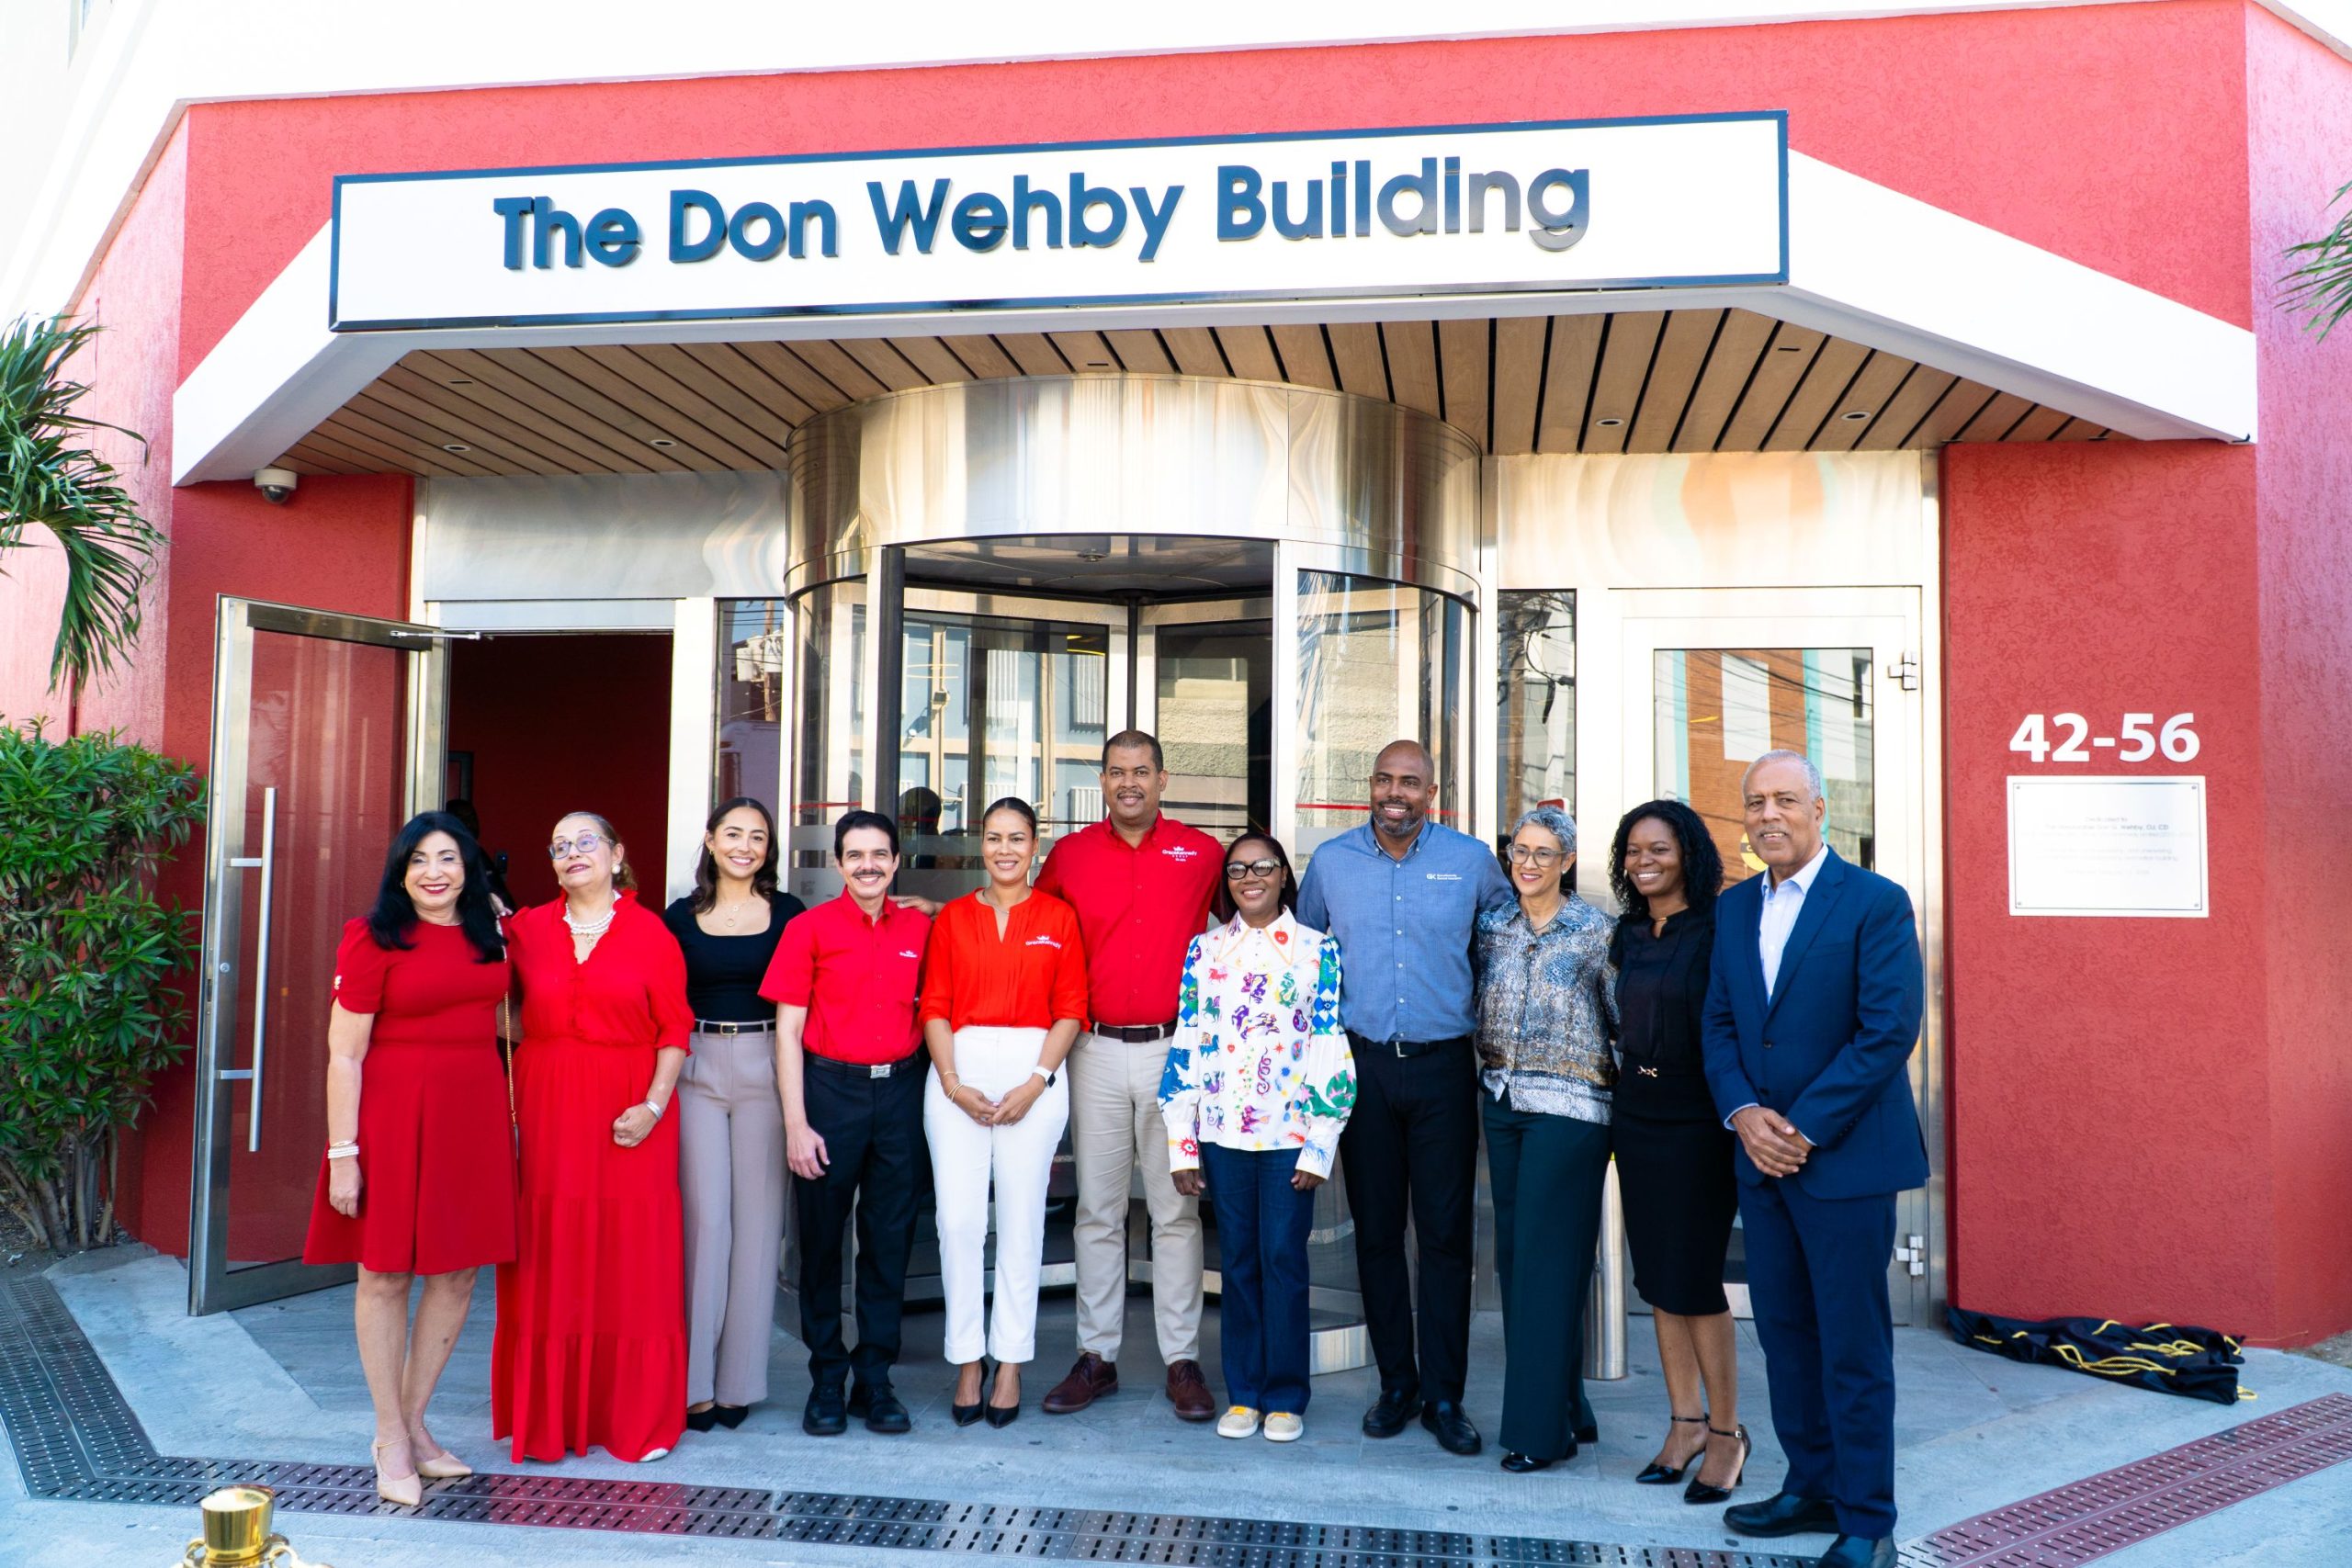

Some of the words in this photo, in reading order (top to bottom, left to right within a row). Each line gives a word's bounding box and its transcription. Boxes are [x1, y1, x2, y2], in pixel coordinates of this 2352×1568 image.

[493, 196, 641, 270] The
[669, 189, 839, 264] Don
[866, 172, 1185, 263] Wehby
[1217, 156, 1590, 253] Building
[2009, 712, 2200, 762] 42-56
